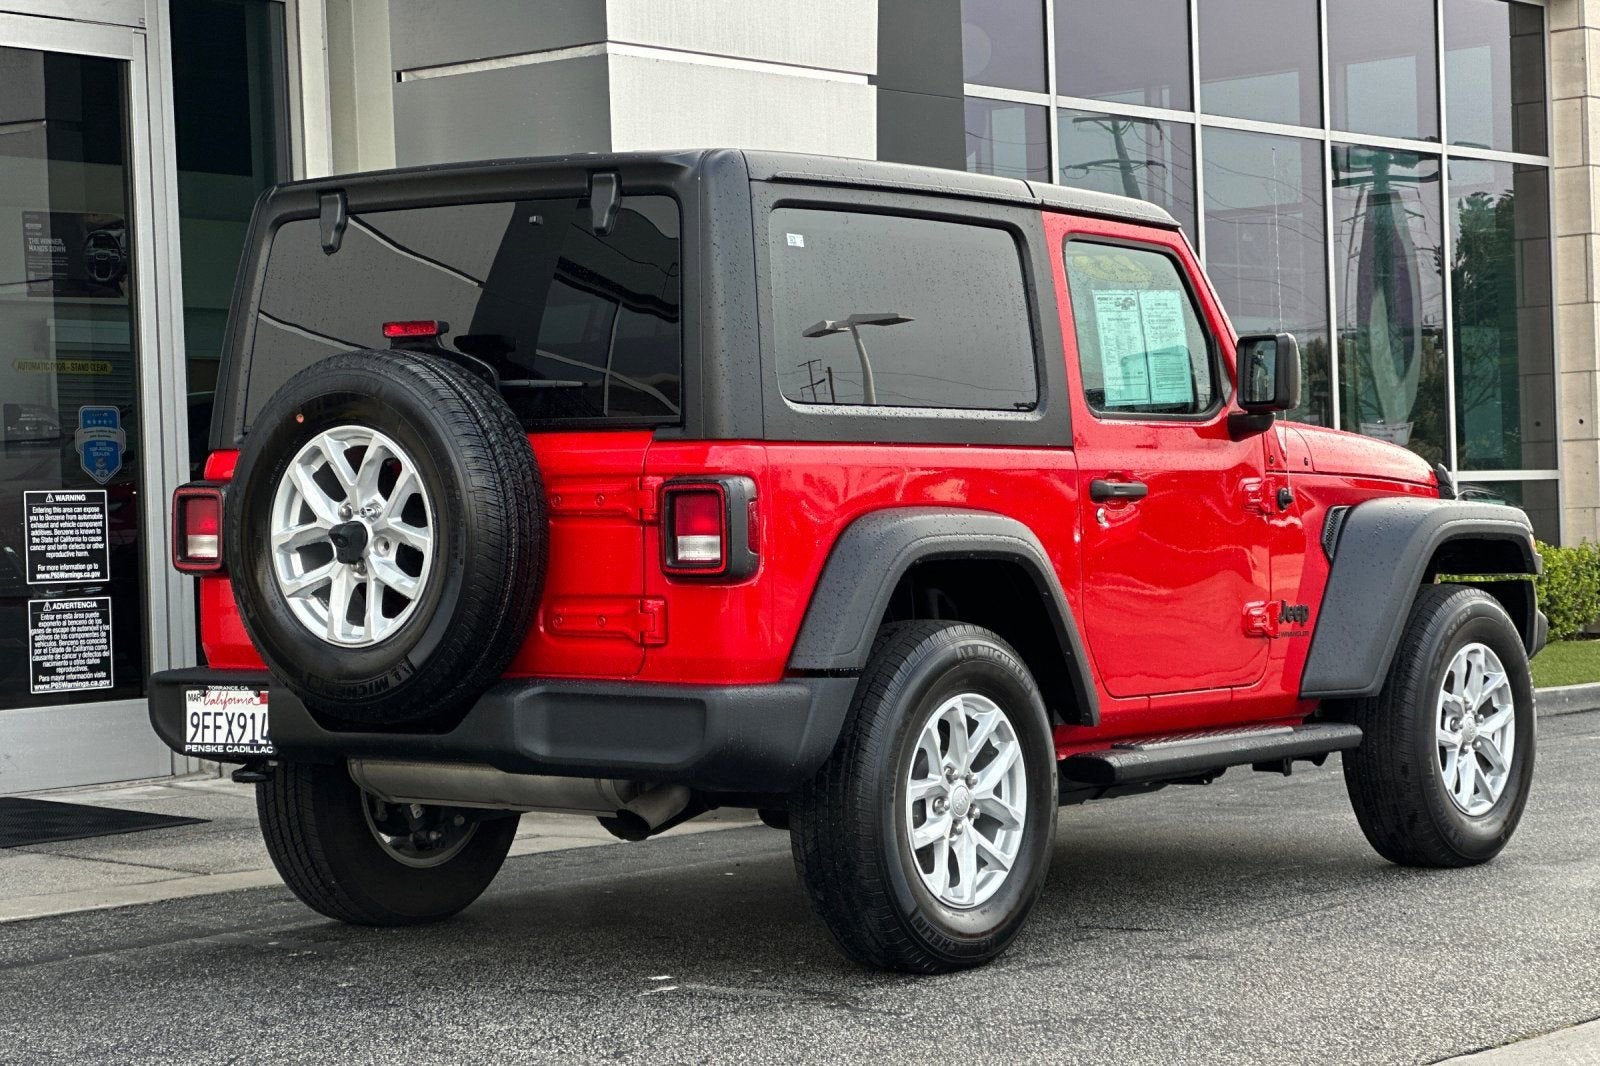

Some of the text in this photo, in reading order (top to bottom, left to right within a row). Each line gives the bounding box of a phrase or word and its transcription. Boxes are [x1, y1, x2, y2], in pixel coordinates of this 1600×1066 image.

[18, 362, 50, 372] AUTOMATIC
[51, 362, 65, 372] DOOR
[71, 362, 89, 372] STAND
[90, 363, 108, 372] CLEAR
[36, 571, 100, 580] www.P65Warnings.ca.gov
[52, 601, 97, 610] ADVERTENCIA
[1279, 600, 1309, 626] Jeep
[978, 644, 1032, 691] MICHELIN
[34, 680, 110, 690] www.P65Warnings.ca.gov
[188, 690, 258, 710] MAR California
